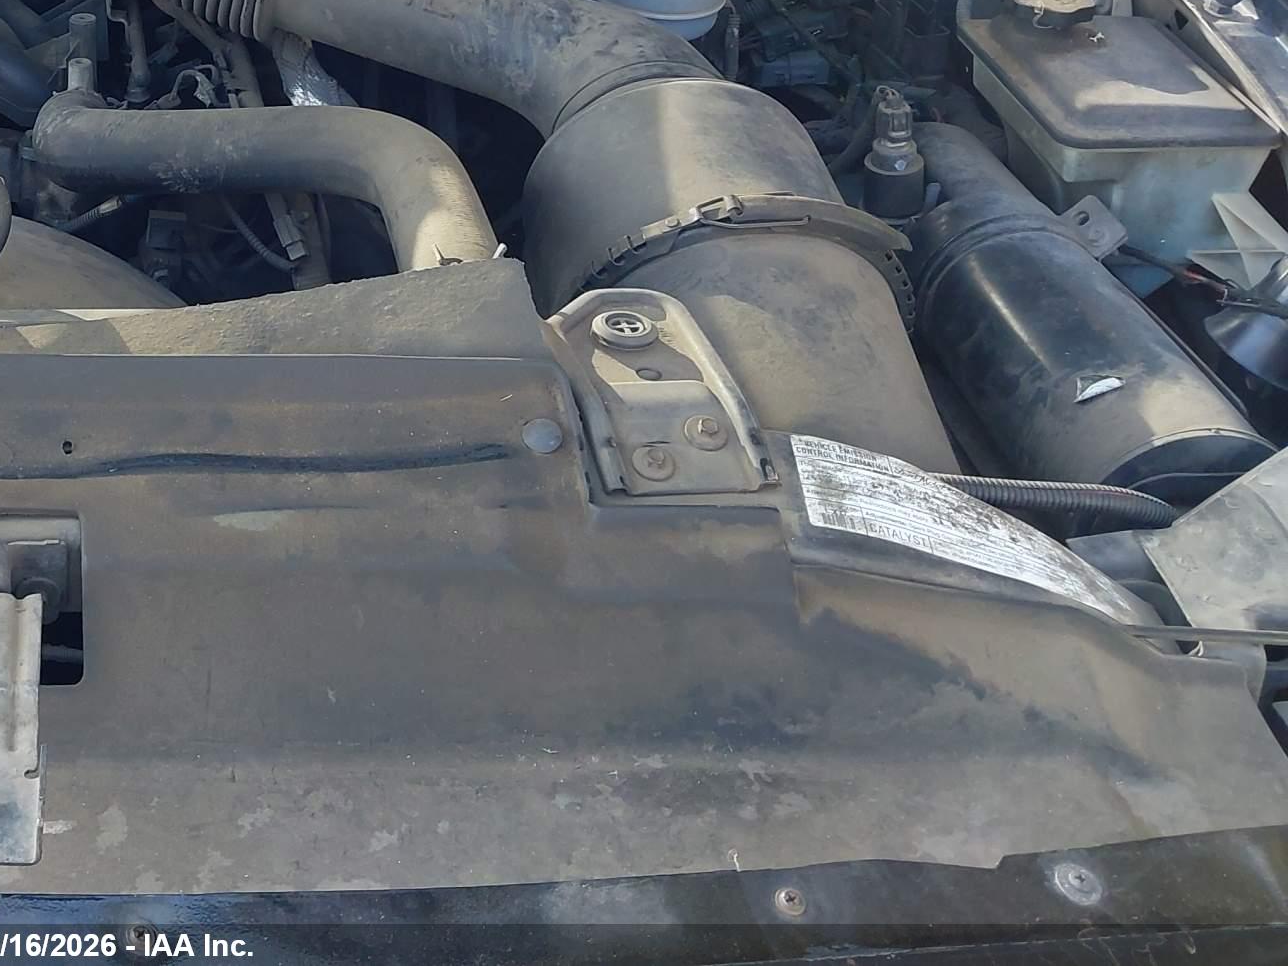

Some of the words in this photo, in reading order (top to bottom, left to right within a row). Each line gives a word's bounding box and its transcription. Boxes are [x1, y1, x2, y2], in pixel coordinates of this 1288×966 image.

[795, 446, 833, 460] CONTROL
[835, 454, 889, 473] INFORMATION
[804, 440, 837, 453] VEHICLE
[839, 444, 878, 462] EMISSION
[869, 522, 929, 548] CATALYST
